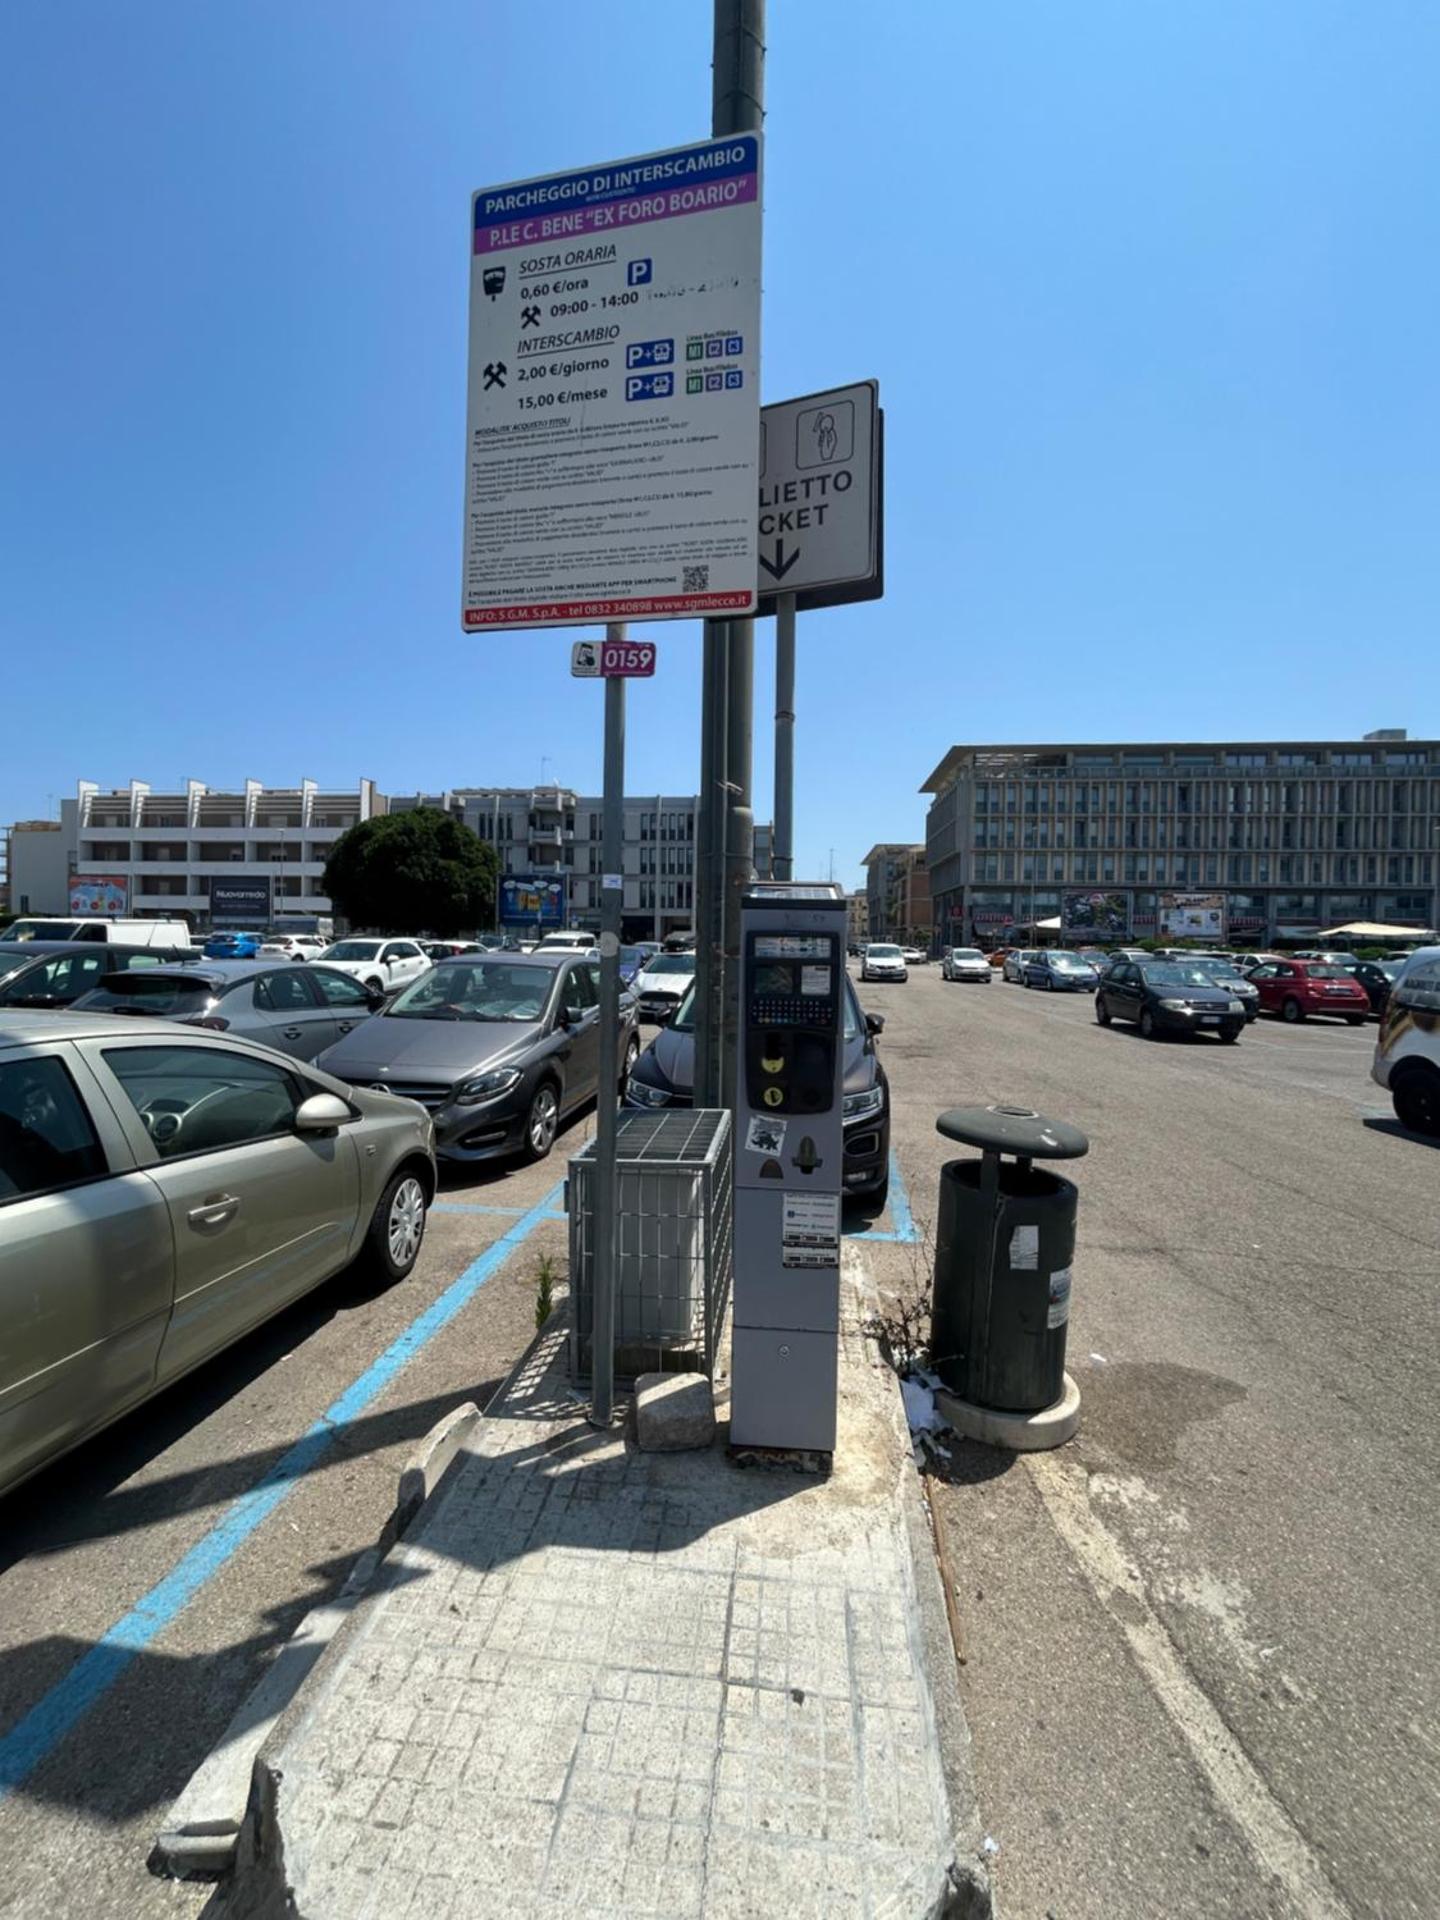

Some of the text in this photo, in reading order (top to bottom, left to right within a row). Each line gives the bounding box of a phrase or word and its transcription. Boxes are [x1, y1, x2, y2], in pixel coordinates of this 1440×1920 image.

[485, 179, 589, 214] PARCHEGGIO
[593, 174, 611, 192] DI
[614, 145, 745, 188] INTERSCAMBIO
[490, 225, 521, 247] P.LE
[523, 222, 538, 240] C.
[542, 212, 584, 238] BENE
[618, 196, 666, 221] FORO
[519, 243, 617, 275] SOSTA ORARIA
[520, 278, 589, 300] 0,60 €/ora
[551, 300, 589, 317] 09:00
[601, 291, 639, 308] 14:00
[517, 324, 620, 354] INTERSCAMBIO
[518, 357, 609, 382] 2,00 €/giorno
[518, 388, 608, 410] 15,00 €/mese
[469, 610, 497, 622] INFO:
[569, 604, 582, 616] tel
[584, 602, 611, 615] 0832
[604, 648, 653, 668] 0159
